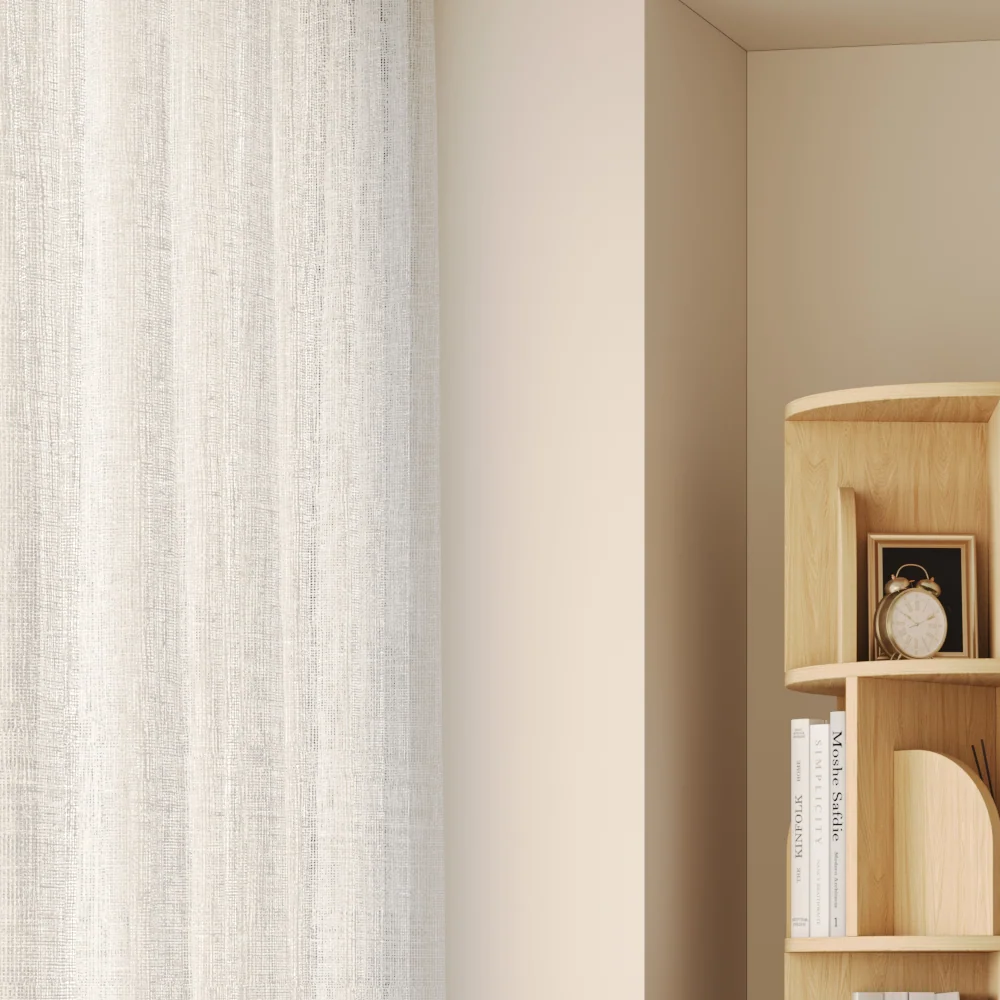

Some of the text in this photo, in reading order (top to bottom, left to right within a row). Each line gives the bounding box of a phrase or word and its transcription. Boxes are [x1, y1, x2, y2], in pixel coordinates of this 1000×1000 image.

[795, 795, 803, 859] KINFOLK
[832, 731, 843, 841] Moshe Safdie
